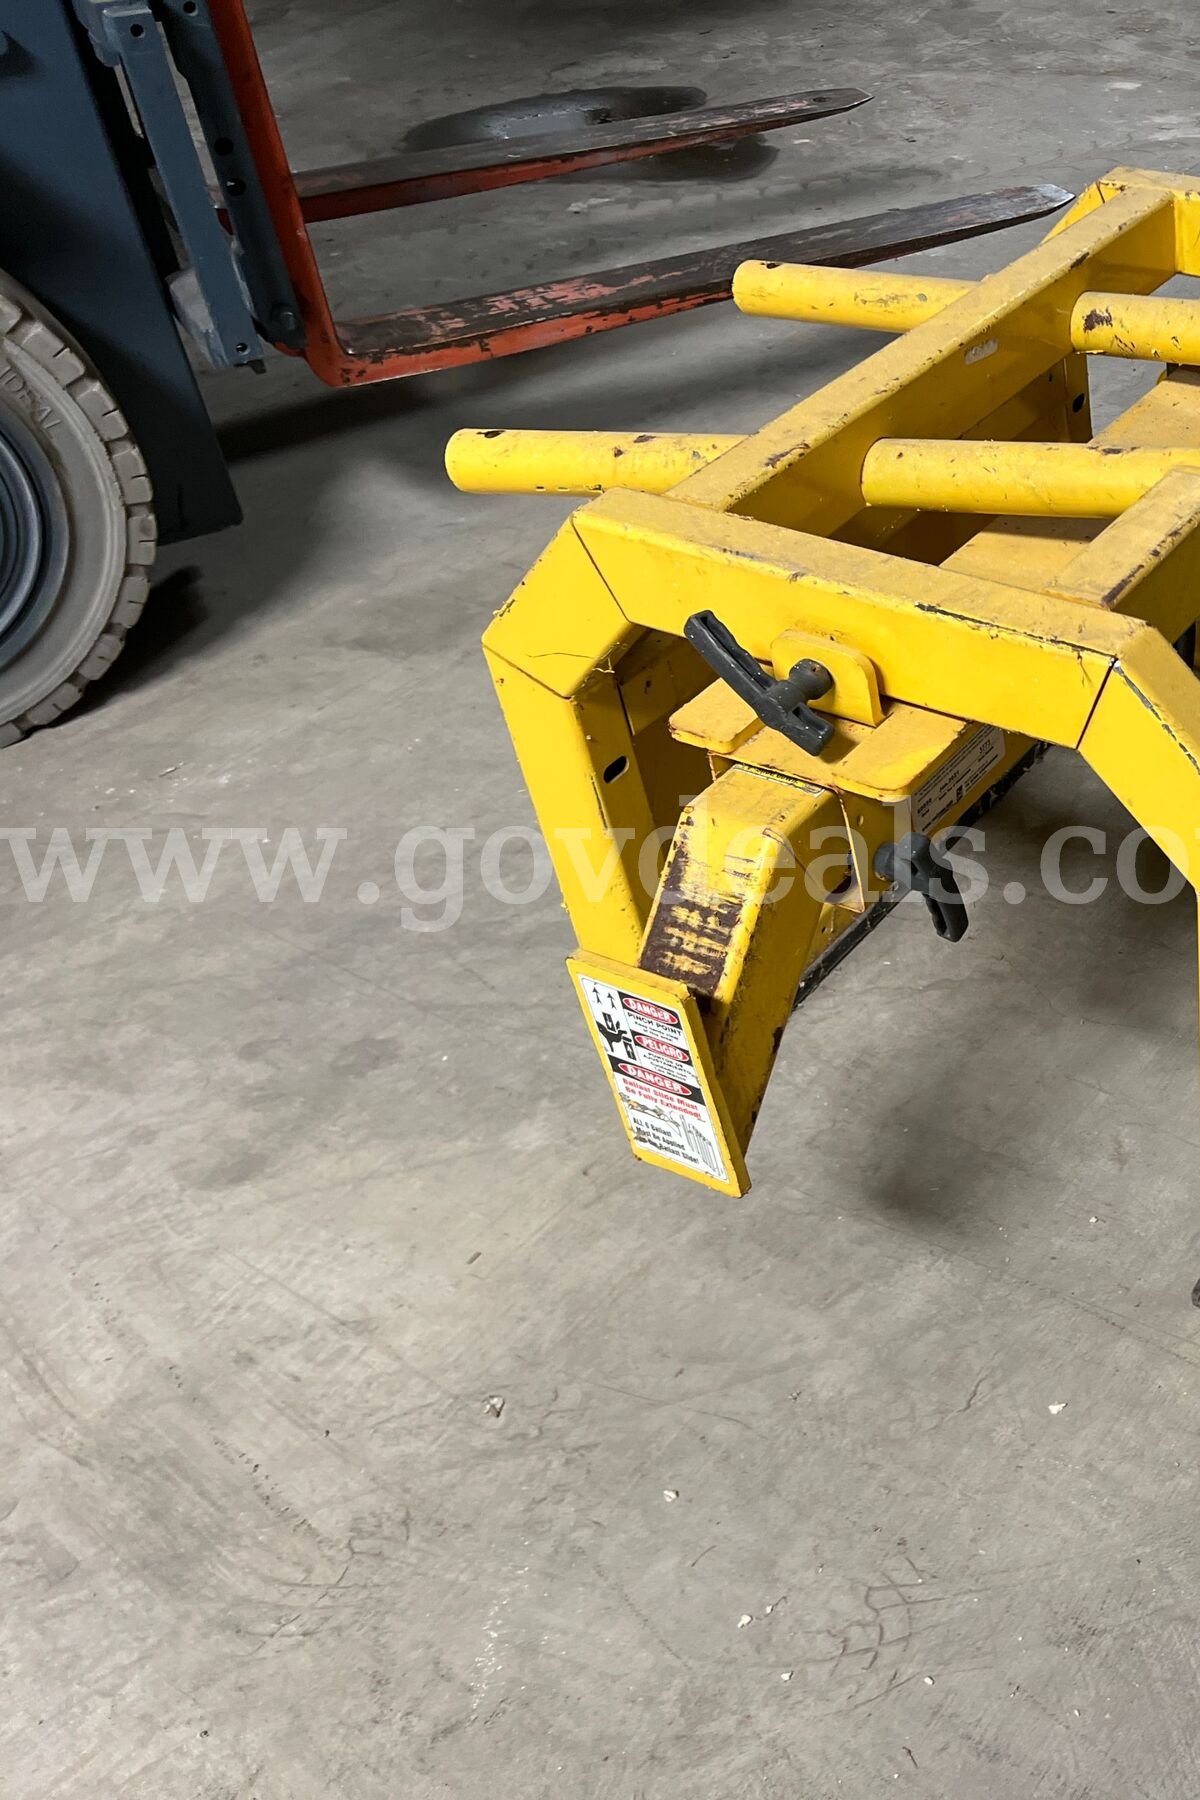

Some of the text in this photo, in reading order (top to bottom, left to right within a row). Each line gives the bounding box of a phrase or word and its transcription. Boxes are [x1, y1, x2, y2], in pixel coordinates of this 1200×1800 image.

[628, 999, 671, 1021] DANGER
[627, 1012, 682, 1035] PINCH POINT
[641, 1036, 682, 1059] PELIGRO
[626, 1065, 682, 1093] DANGER
[622, 1078, 698, 1110] Ballast Slide Must
[624, 1086, 636, 1094] Be
[638, 1091, 657, 1102] Fully
